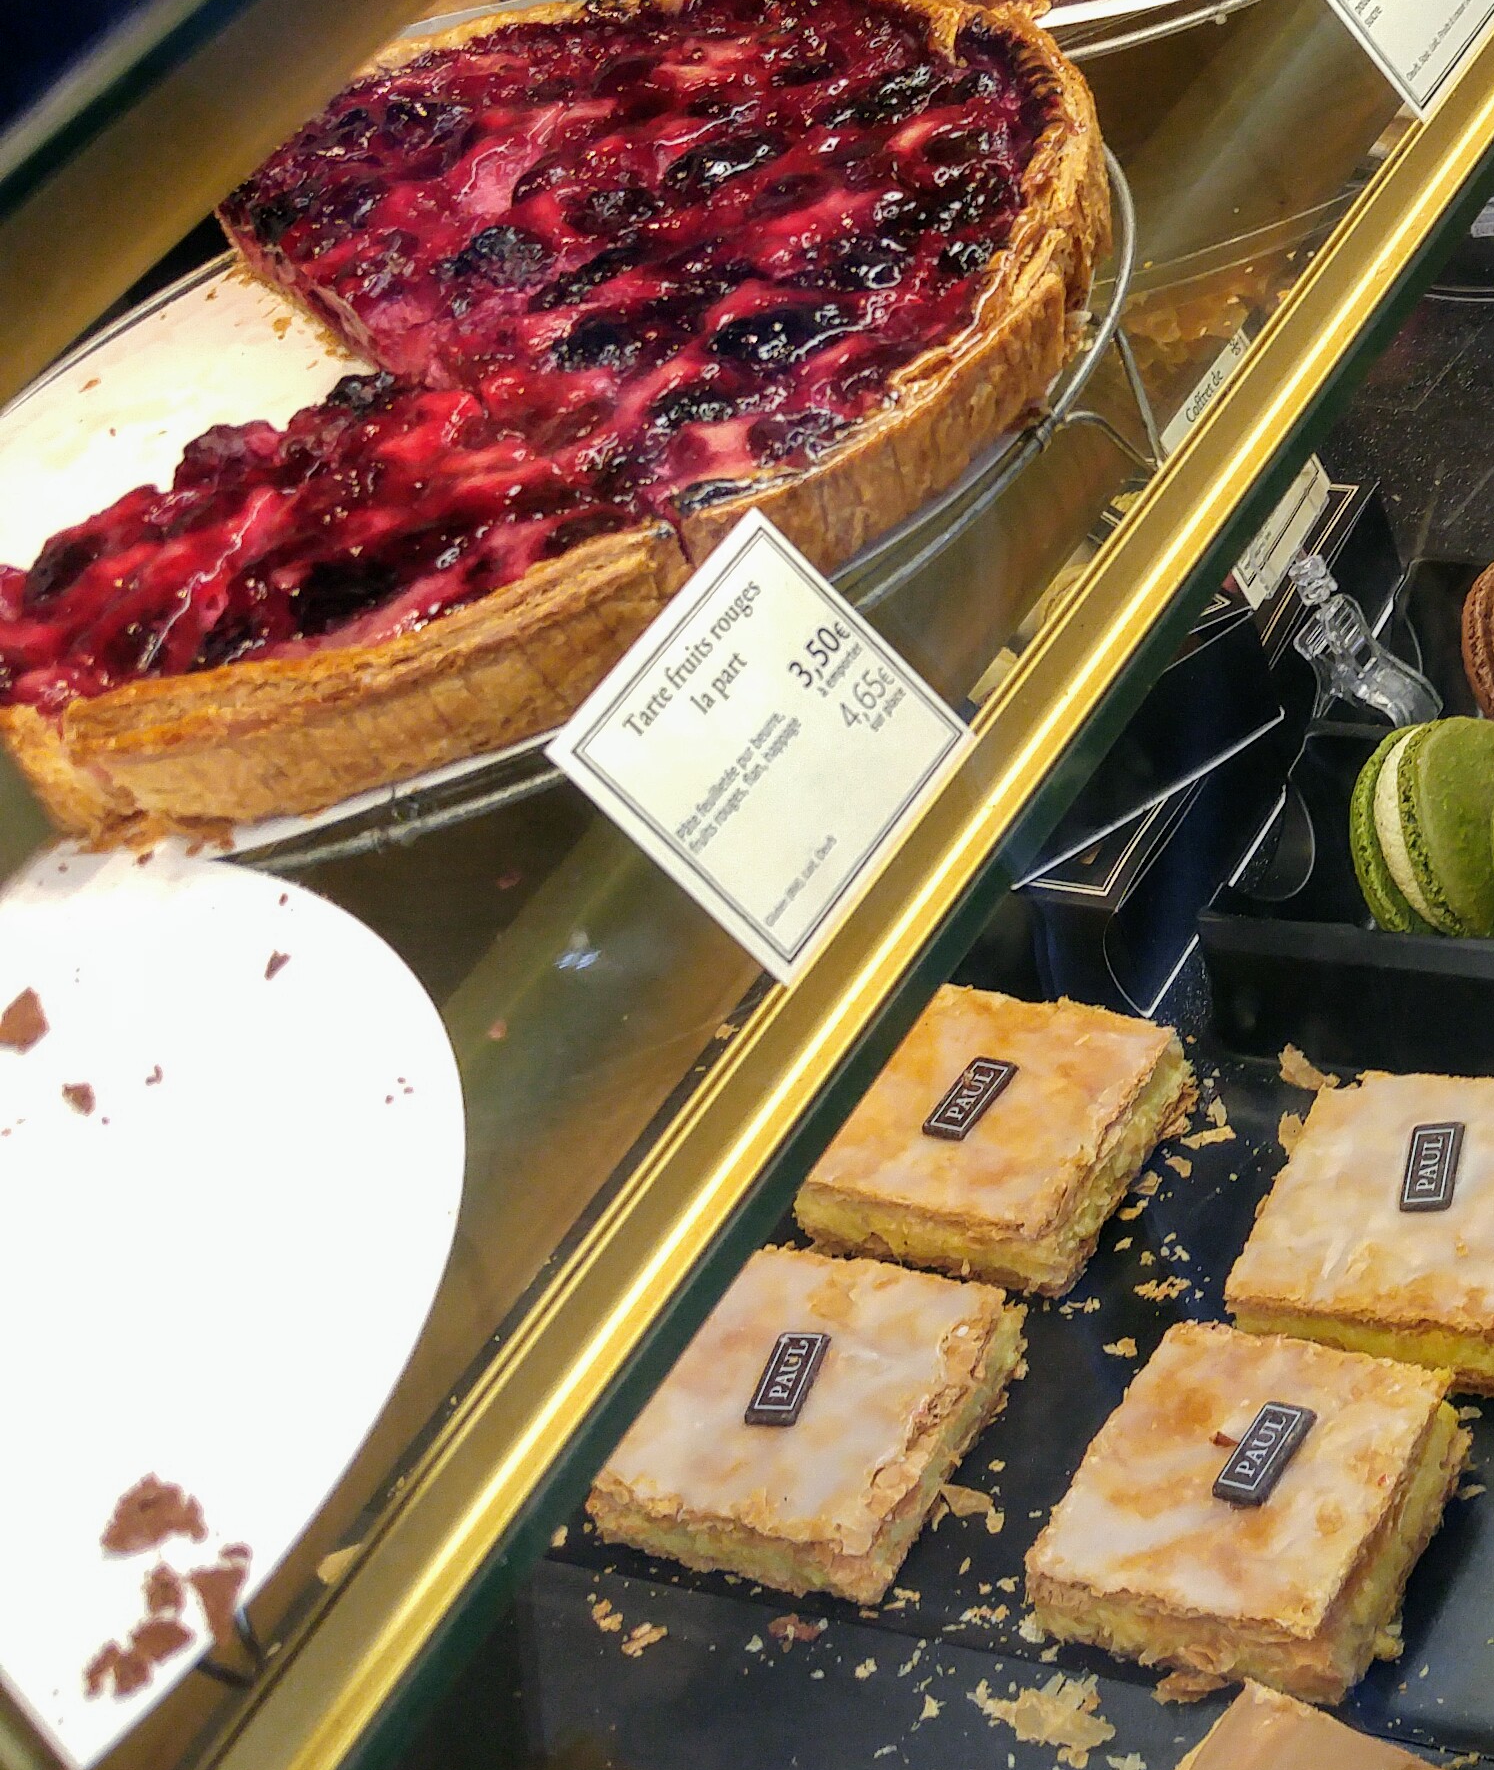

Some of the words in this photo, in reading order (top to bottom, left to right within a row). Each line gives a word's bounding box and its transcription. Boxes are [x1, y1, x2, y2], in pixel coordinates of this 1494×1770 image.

[1185, 382, 1216, 423] Coffret
[622, 686, 672, 736] Tarte
[664, 637, 713, 689] fruits
[709, 581, 760, 640] rouges
[689, 692, 715, 714] la
[711, 652, 747, 700] part
[787, 622, 849, 688] 3,50€
[825, 643, 860, 688] emporter
[839, 668, 893, 727] 4,65€
[869, 713, 884, 731] sur
[882, 687, 904, 717] place
[688, 822, 717, 853] fruits
[763, 717, 801, 762] nappage
[735, 746, 753, 770] pur
[945, 1071, 995, 1121] PAUL
[1415, 1135, 1444, 1191] PAUL
[768, 1340, 809, 1400] PAUL
[1235, 1415, 1287, 1477] PAUL
